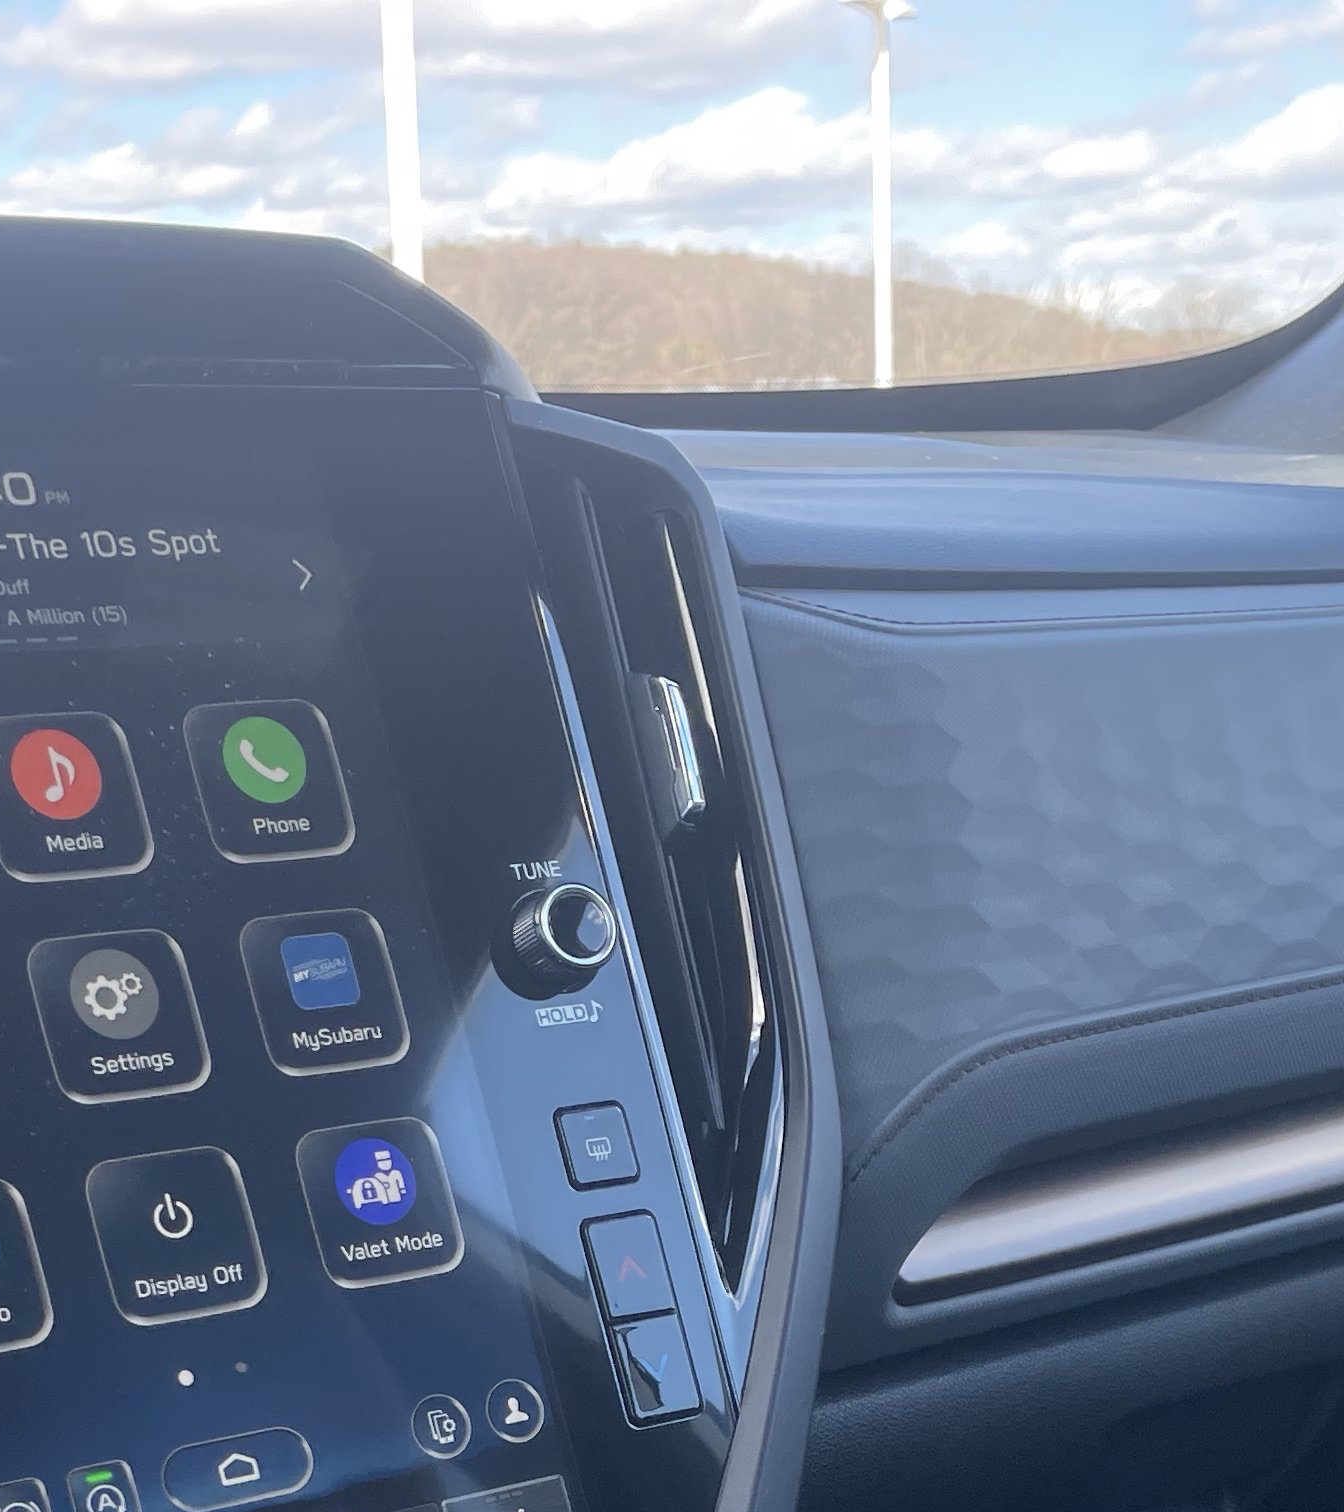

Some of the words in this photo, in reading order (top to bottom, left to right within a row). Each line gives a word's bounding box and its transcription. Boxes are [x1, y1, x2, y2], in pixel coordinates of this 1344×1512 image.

[45, 490, 71, 505] PM
[80, 530, 136, 558] 10s
[147, 528, 221, 561] Spot
[7, 609, 21, 626] A
[27, 606, 85, 625] Million
[92, 604, 128, 626] (15)
[252, 815, 311, 835] Phone
[46, 832, 104, 853] Media
[511, 861, 562, 881] TUNE
[537, 1004, 585, 1024] HOLD
[292, 1025, 383, 1052] MySubaru
[91, 1049, 175, 1076] Settings
[340, 1236, 390, 1262] Valet
[396, 1230, 443, 1254] Mode
[134, 1270, 208, 1300] Display
[213, 1263, 244, 1286] Off
